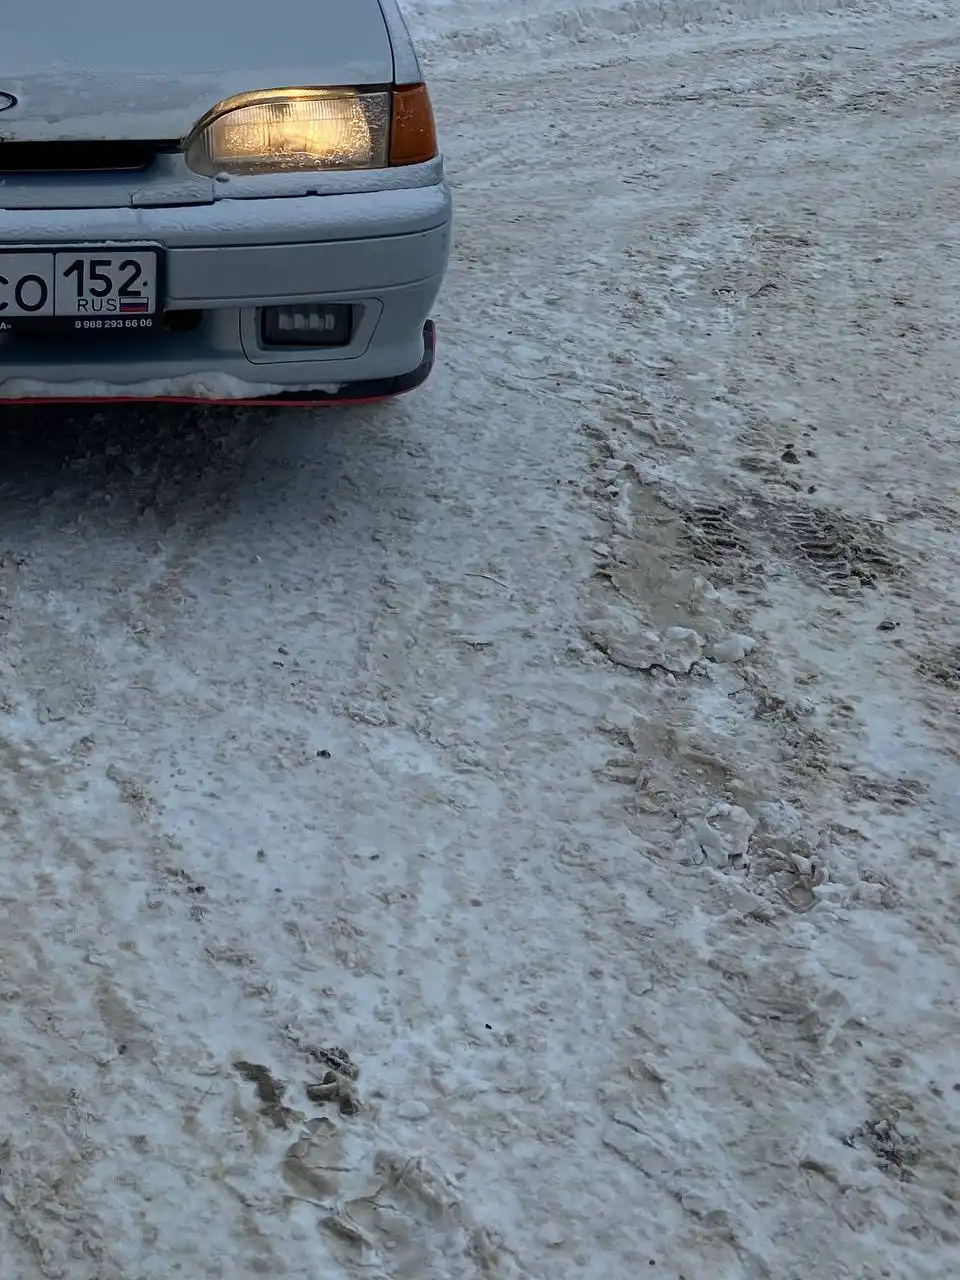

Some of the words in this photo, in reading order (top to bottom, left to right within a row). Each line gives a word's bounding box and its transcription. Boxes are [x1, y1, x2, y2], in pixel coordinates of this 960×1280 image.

[63, 259, 142, 297] 152
[77, 298, 117, 312] RUS
[104, 320, 123, 328] 293
[125, 319, 138, 327] 66
